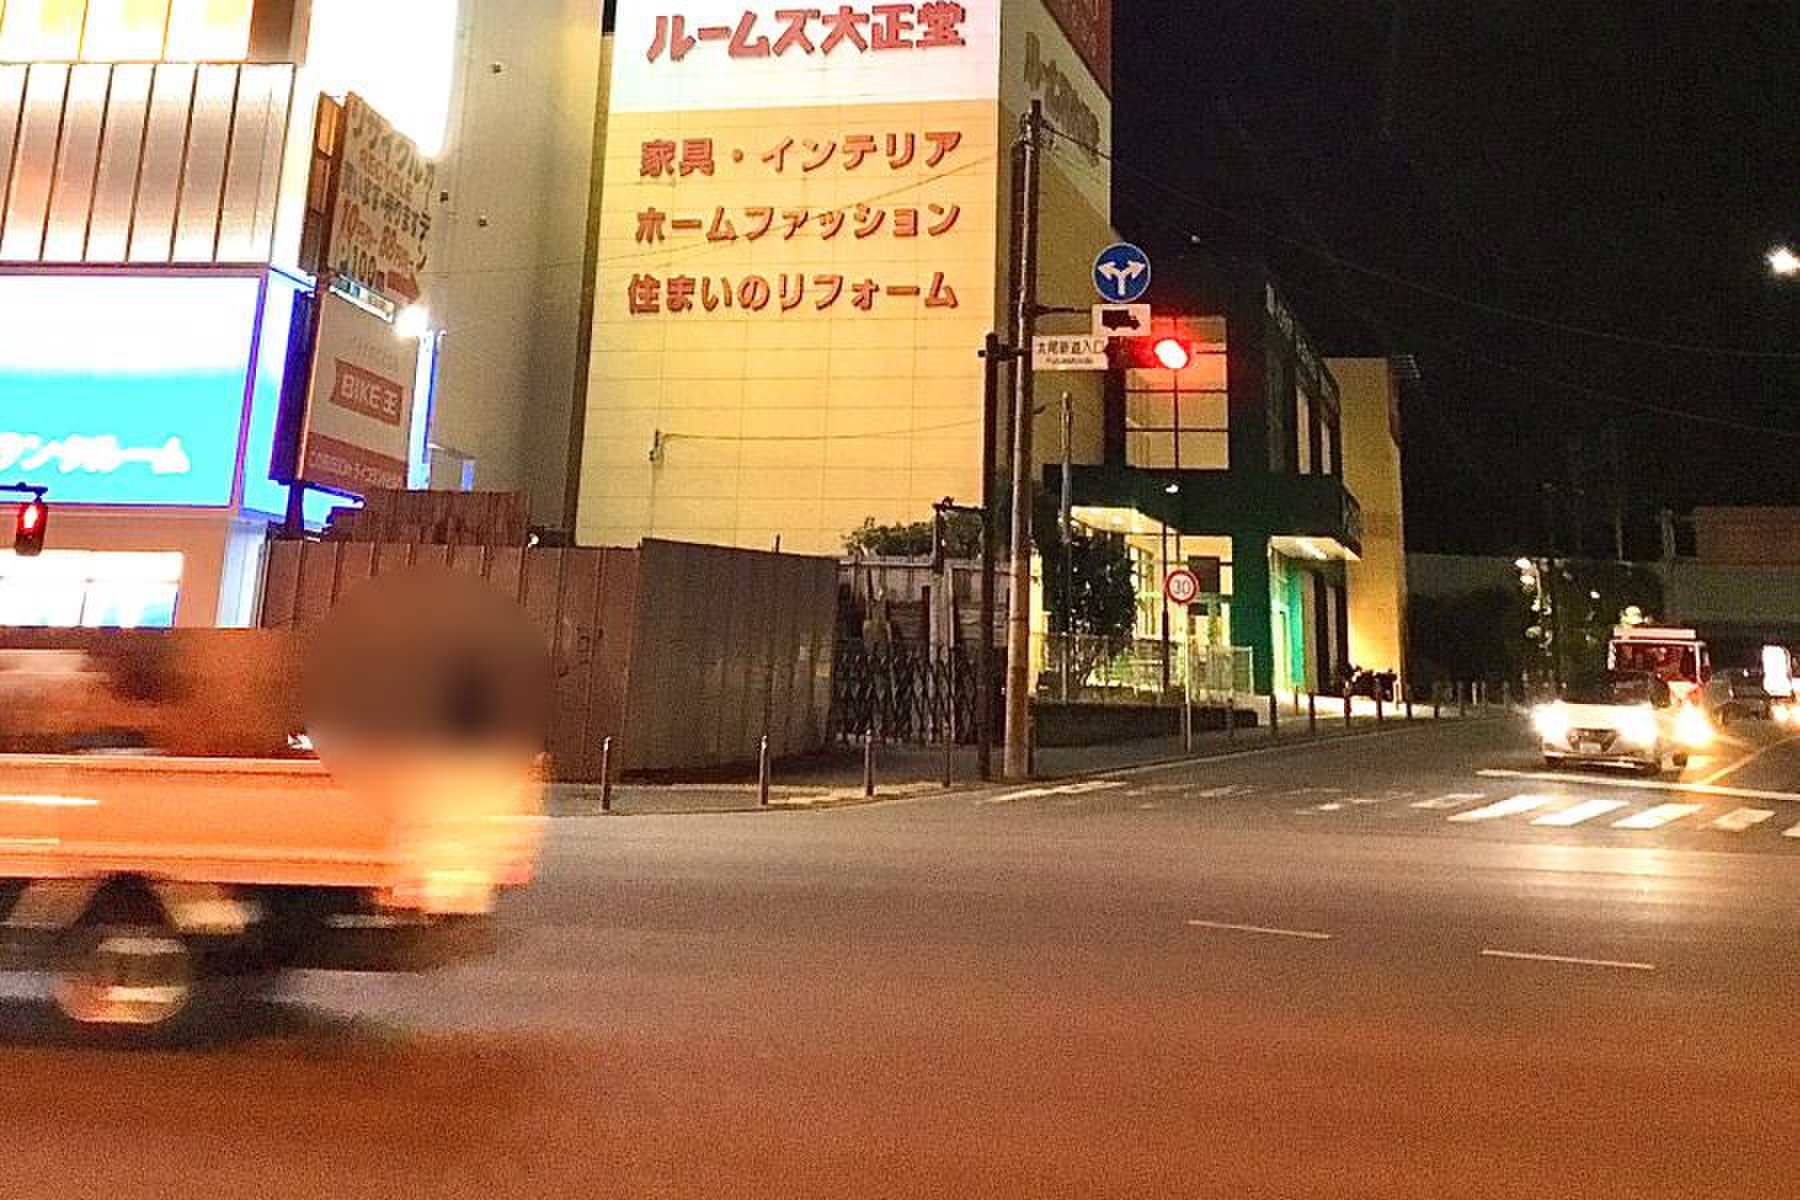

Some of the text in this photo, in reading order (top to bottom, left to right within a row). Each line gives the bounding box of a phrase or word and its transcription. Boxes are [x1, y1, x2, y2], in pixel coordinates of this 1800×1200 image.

[646, 0, 967, 63] ルームズ大正堂
[639, 131, 962, 177] 家具・インテリア
[634, 202, 961, 244] ホームファッション
[626, 271, 959, 315] 住まいのリフォーム
[1172, 578, 1192, 596] 30
